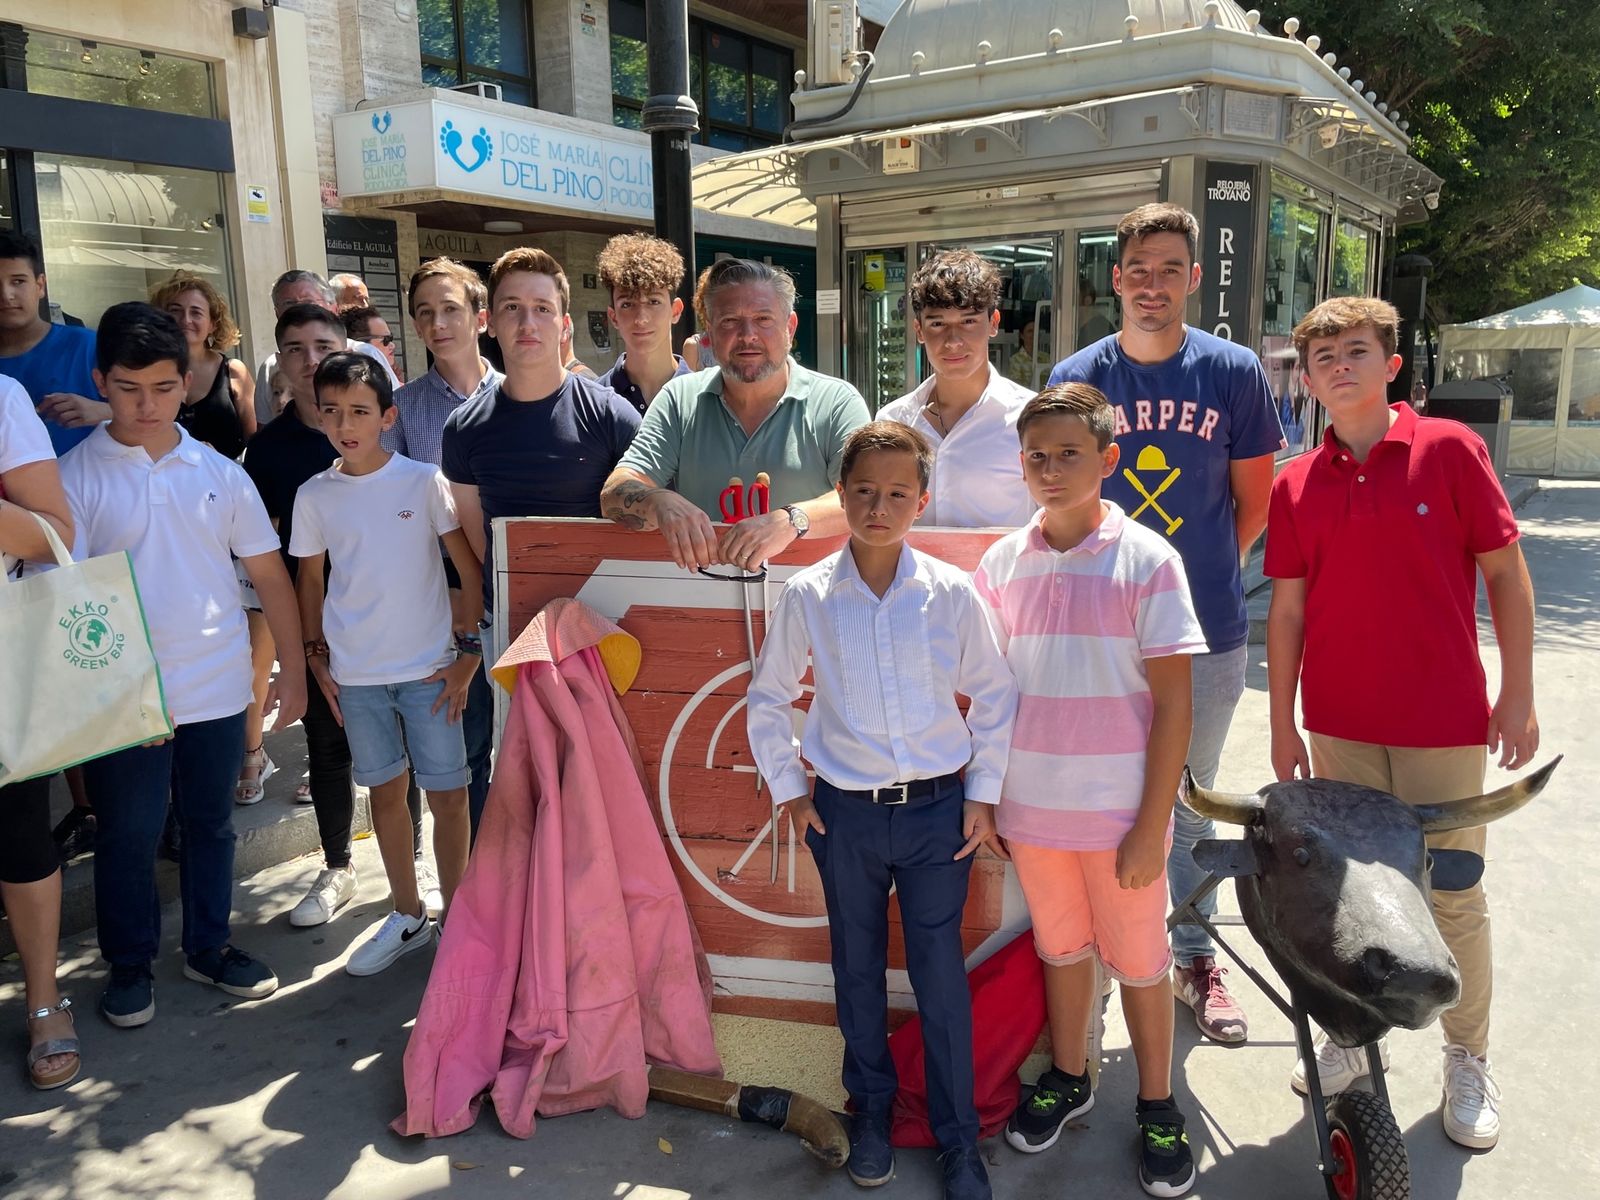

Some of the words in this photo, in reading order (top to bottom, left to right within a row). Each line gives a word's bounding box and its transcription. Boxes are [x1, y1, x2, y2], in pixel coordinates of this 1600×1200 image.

[362, 149, 381, 163] DEL
[500, 131, 540, 157] JOSÉ
[548, 141, 602, 168] MARÍA
[501, 158, 547, 192] DEL
[1217, 180, 1250, 190] RELOJERÍA
[1208, 188, 1251, 202] TROYANO
[327, 239, 352, 250] Edificio
[353, 241, 363, 251] EL
[364, 242, 392, 253] AGUILA
[425, 233, 482, 254] AGUILA
[1113, 399, 1220, 442] ARPER
[59, 601, 108, 629] EKKO
[63, 649, 109, 670] GREEN
[110, 633, 125, 660] BAG
